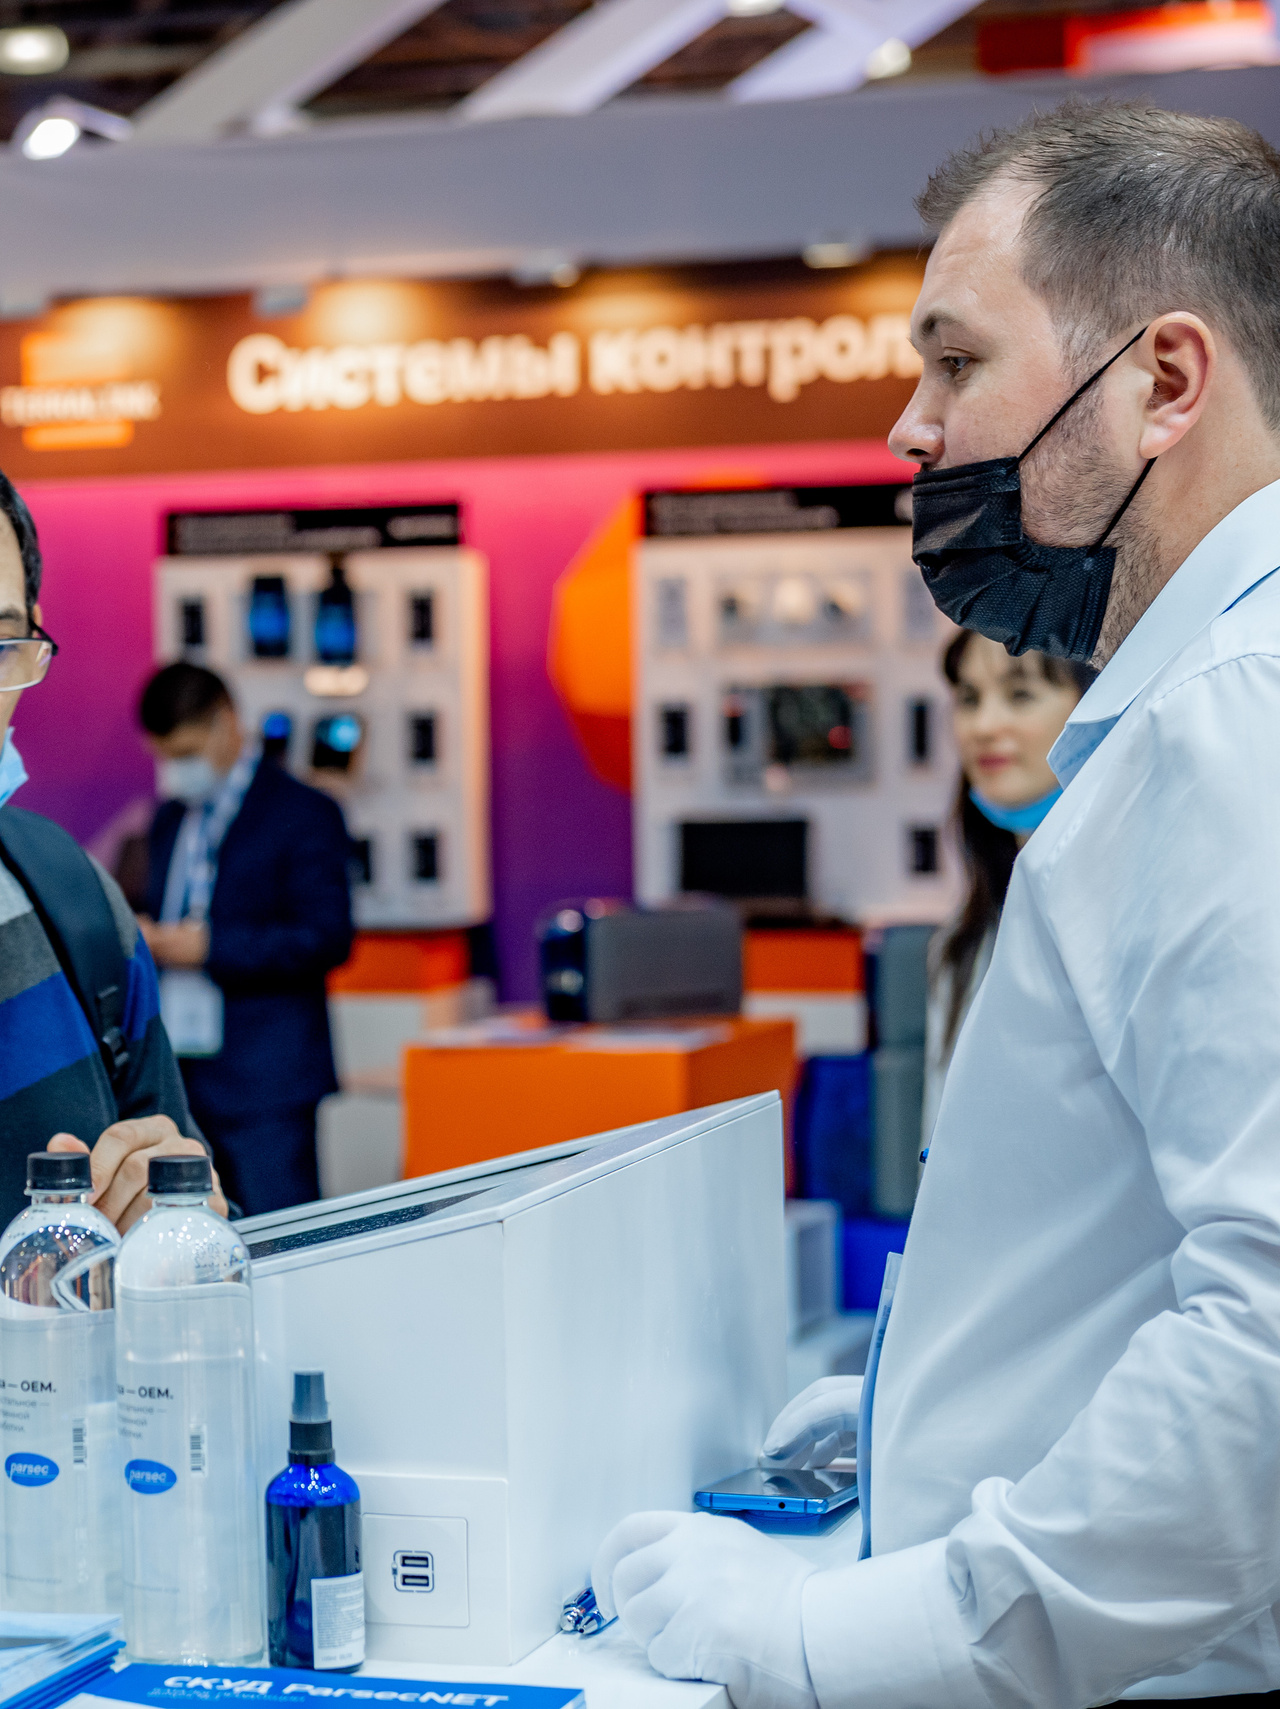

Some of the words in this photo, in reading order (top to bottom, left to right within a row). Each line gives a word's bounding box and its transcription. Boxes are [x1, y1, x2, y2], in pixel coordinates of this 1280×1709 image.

[227, 331, 581, 415] Системы
[20, 1380, 57, 1393] OEM.
[10, 1461, 49, 1481] parsec
[129, 1468, 167, 1487] parsec
[163, 1675, 274, 1695] СКУД
[282, 1683, 510, 1707] ParsecNET
